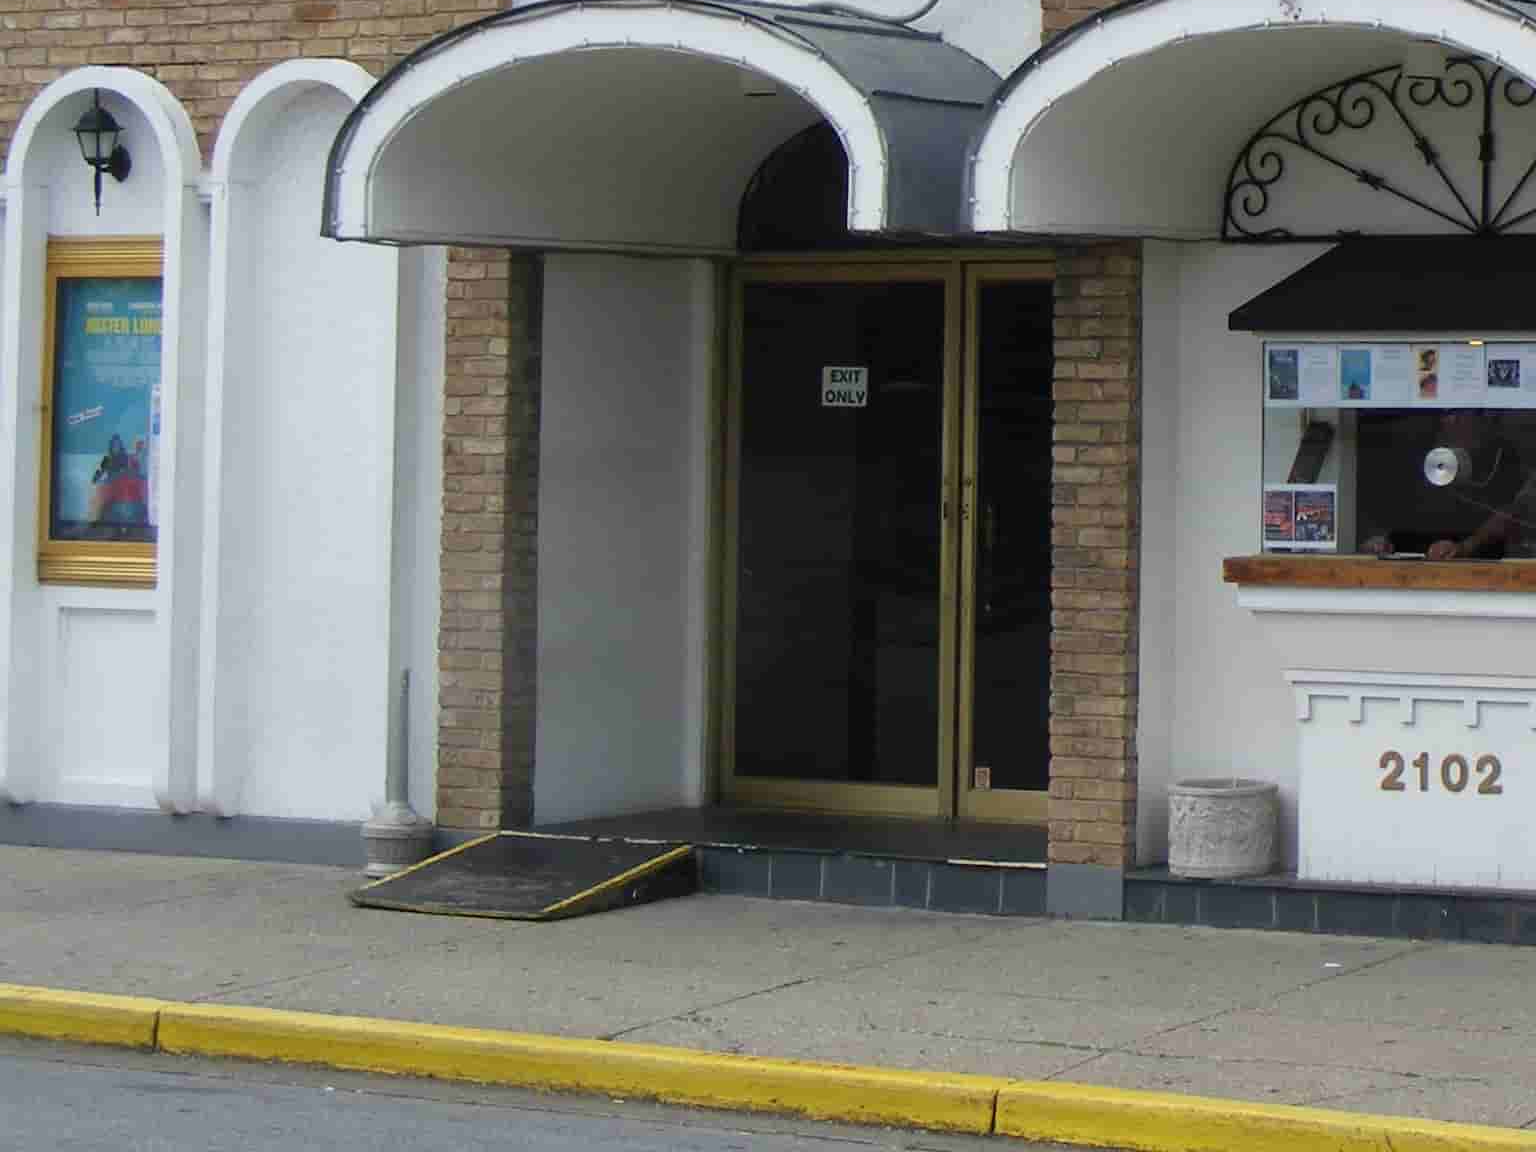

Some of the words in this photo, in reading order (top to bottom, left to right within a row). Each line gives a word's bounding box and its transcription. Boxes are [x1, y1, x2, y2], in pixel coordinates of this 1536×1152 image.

[831, 369, 861, 383] EXIT
[825, 390, 865, 403] ONLY
[1379, 750, 1503, 794] 2102
